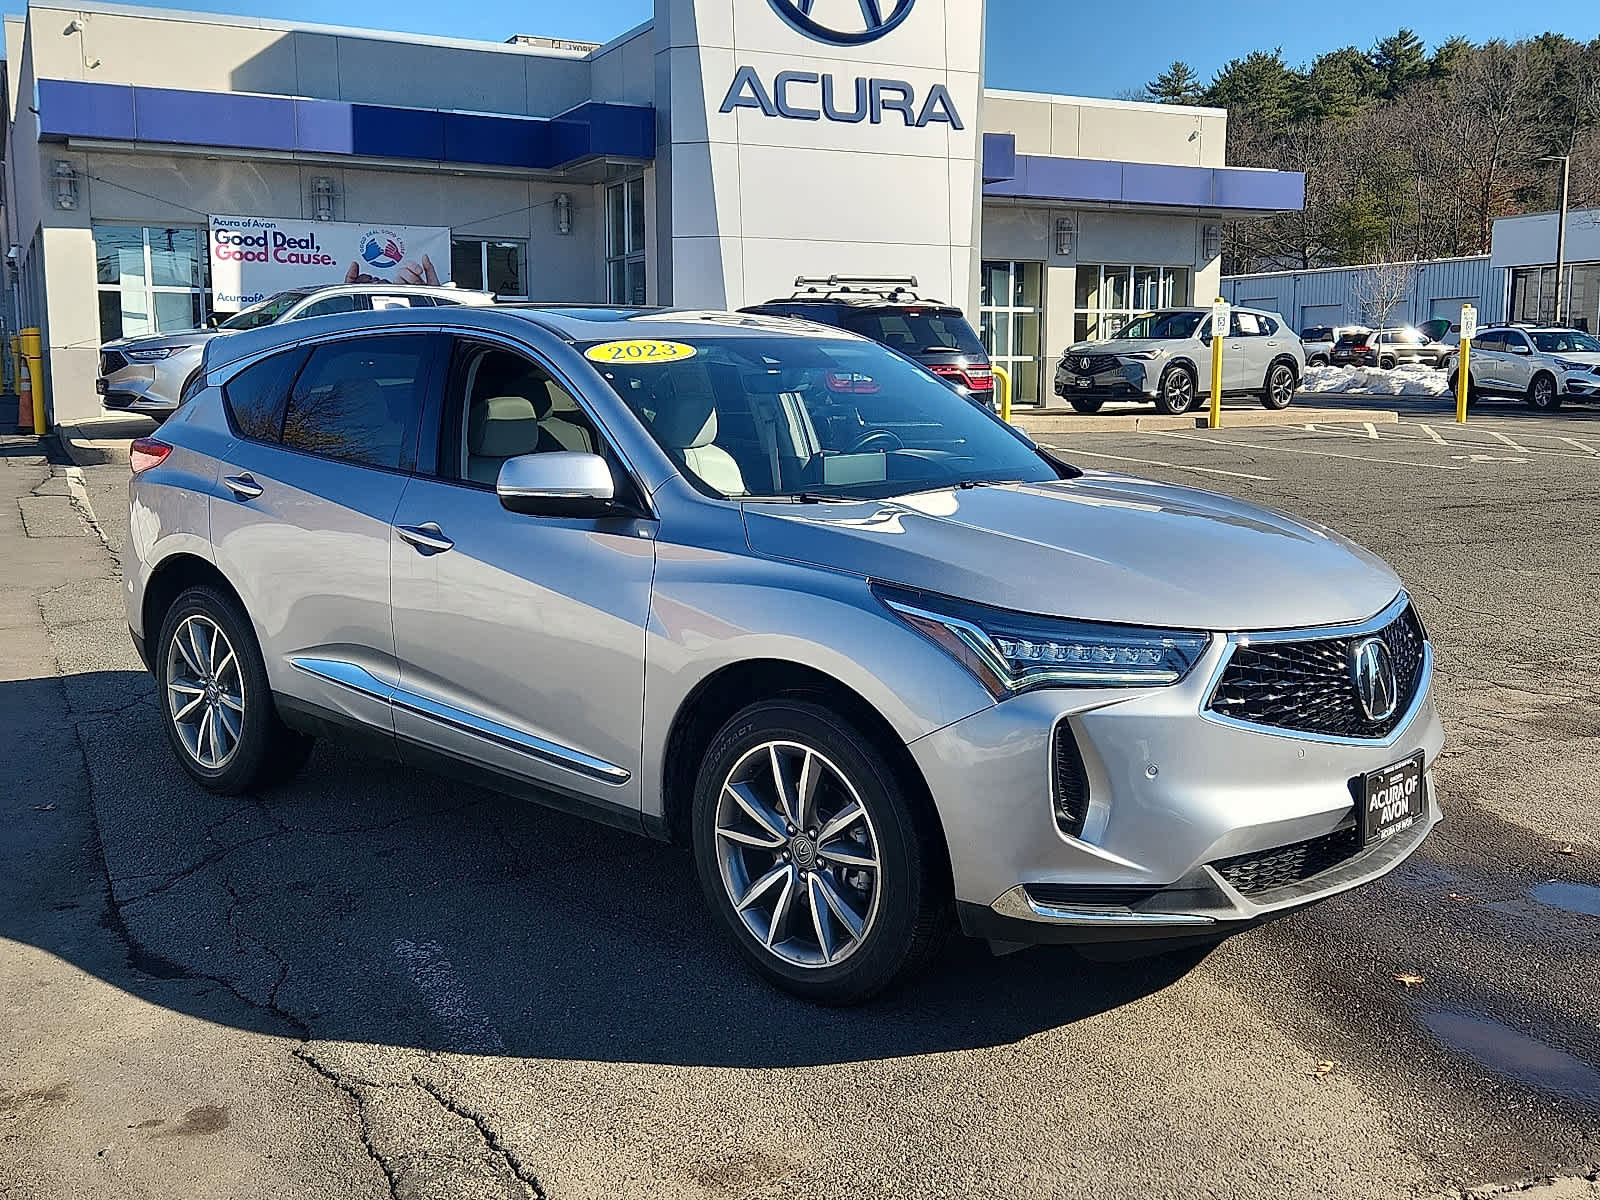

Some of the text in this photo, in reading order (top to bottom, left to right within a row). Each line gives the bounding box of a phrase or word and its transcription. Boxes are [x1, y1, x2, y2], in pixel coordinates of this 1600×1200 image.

[719, 65, 964, 130] ACURA
[213, 217, 277, 229] Acura of Avon
[215, 228, 321, 253] Good Deal,
[215, 243, 337, 266] Good Cause.
[608, 343, 677, 361] 2023
[1369, 784, 1405, 812] ACURA
[1404, 775, 1418, 796] OF
[1380, 797, 1409, 825] AVON
